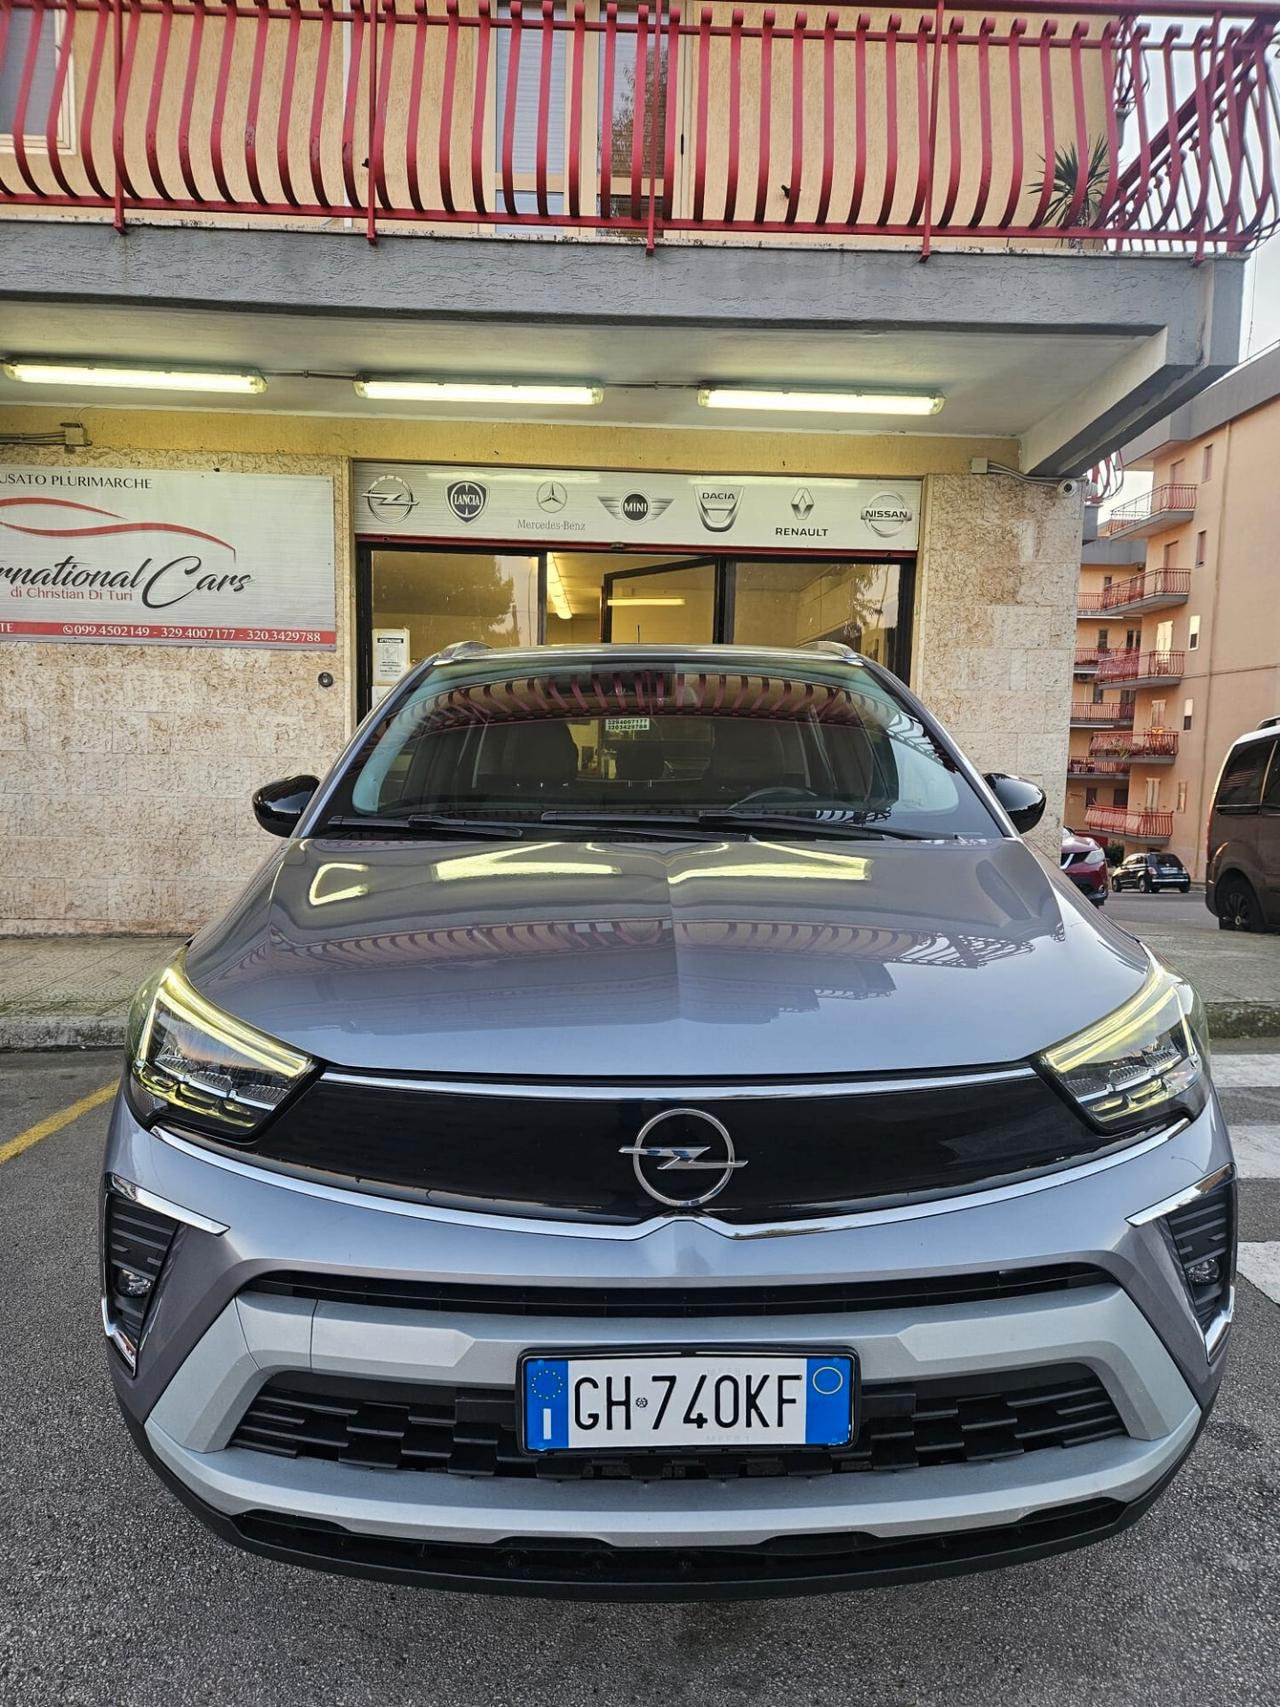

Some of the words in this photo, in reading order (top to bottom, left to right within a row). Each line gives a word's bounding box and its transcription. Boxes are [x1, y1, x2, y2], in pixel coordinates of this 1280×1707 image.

[51, 474, 153, 490] PLURIMARCHE
[454, 493, 480, 506] LANCIA
[702, 492, 736, 501] DACIA
[624, 502, 647, 513] MINI
[865, 509, 908, 519] NISSAN
[517, 519, 586, 531] Mercedes-Benz
[775, 527, 829, 537] RENAULT
[142, 555, 254, 609] Cars
[10, 586, 22, 598] di
[26, 587, 85, 600] Christian
[89, 589, 103, 600] Di
[108, 589, 133, 601] Turi
[74, 624, 150, 637] 099.4502149
[160, 627, 236, 640] 329.4007177
[247, 630, 321, 643] 320.3429788
